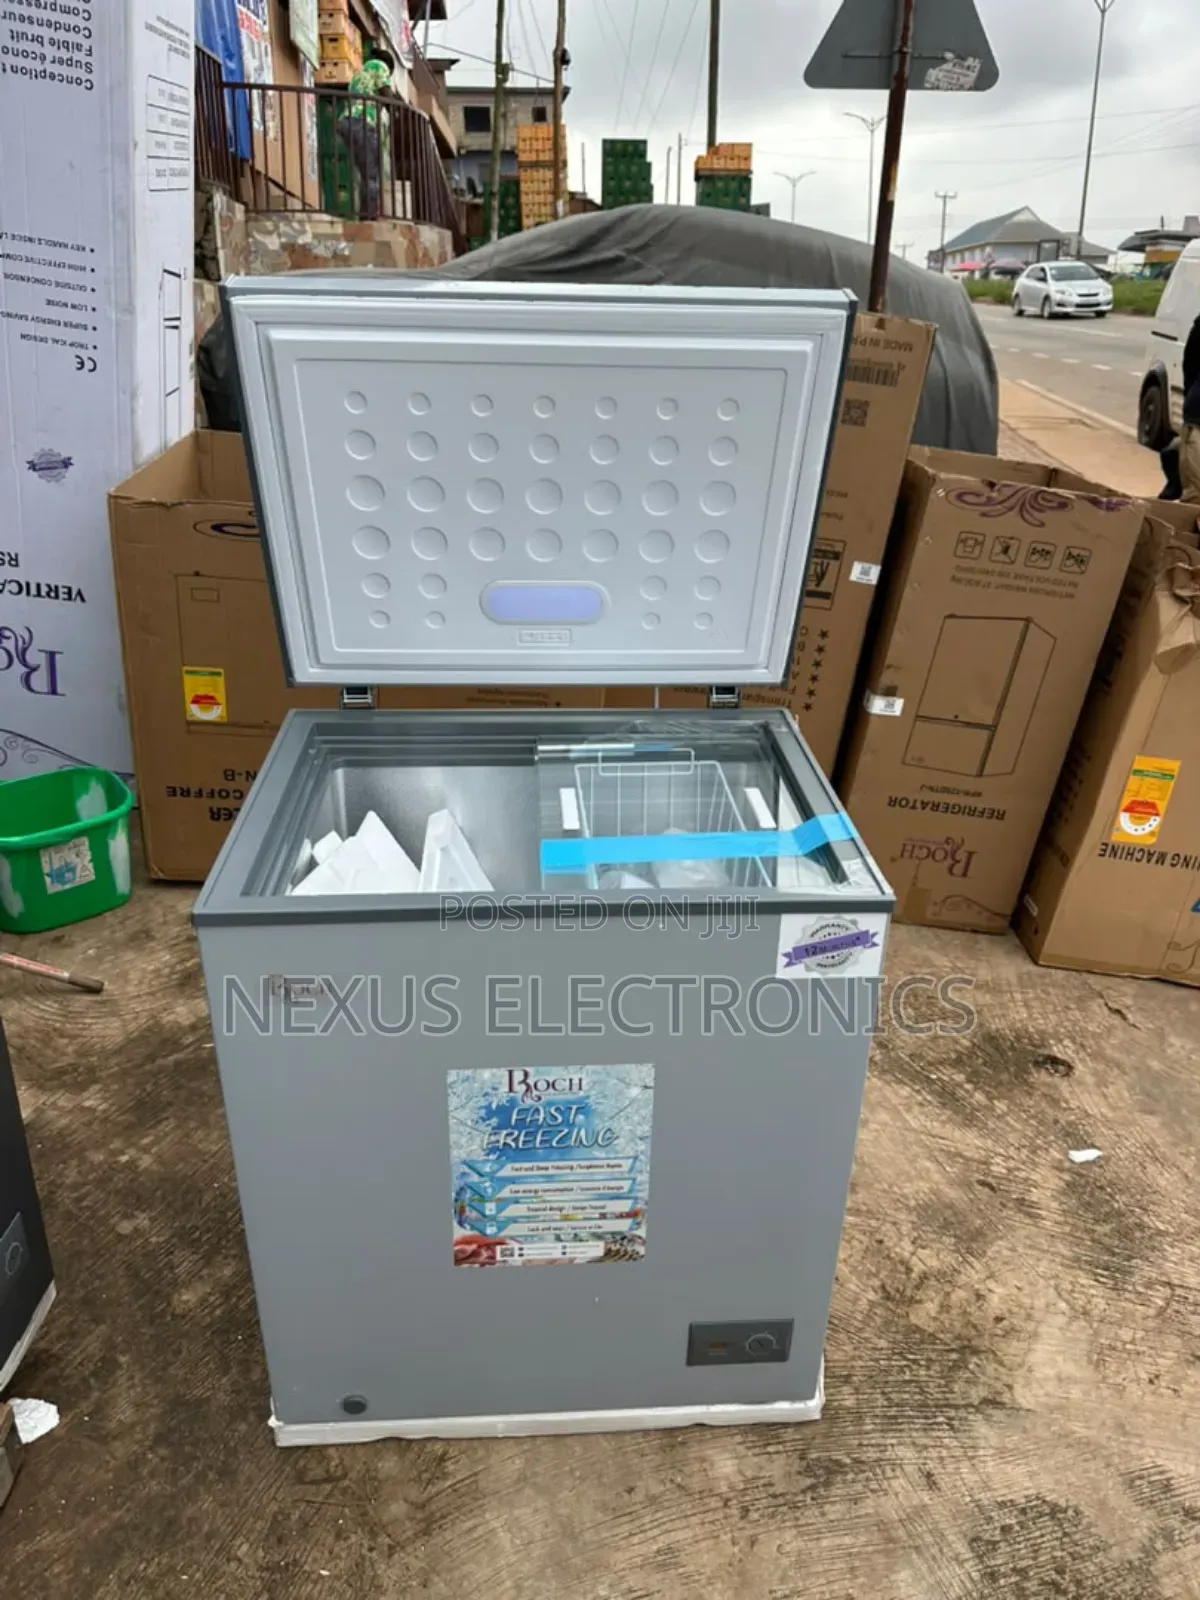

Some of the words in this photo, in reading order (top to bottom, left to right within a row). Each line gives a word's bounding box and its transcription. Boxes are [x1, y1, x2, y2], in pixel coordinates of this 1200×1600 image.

[1, 10, 92, 39] Condenseur
[9, 28, 44, 48] bruit
[48, 37, 93, 57] Faible
[1, 45, 47, 65] écono
[50, 55, 93, 74] Super
[10, 65, 94, 91] Conception
[69, 302, 88, 313] LOW
[31, 315, 62, 327] ENERGY
[20, 331, 49, 345] DESIGN
[165, 785, 244, 800] COFFRE
[887, 795, 1007, 821] REFRIGERATOR
[1098, 842, 1169, 866] MACHINE
[510, 1103, 586, 1127] FAST
[483, 1127, 618, 1149] FREEZING
